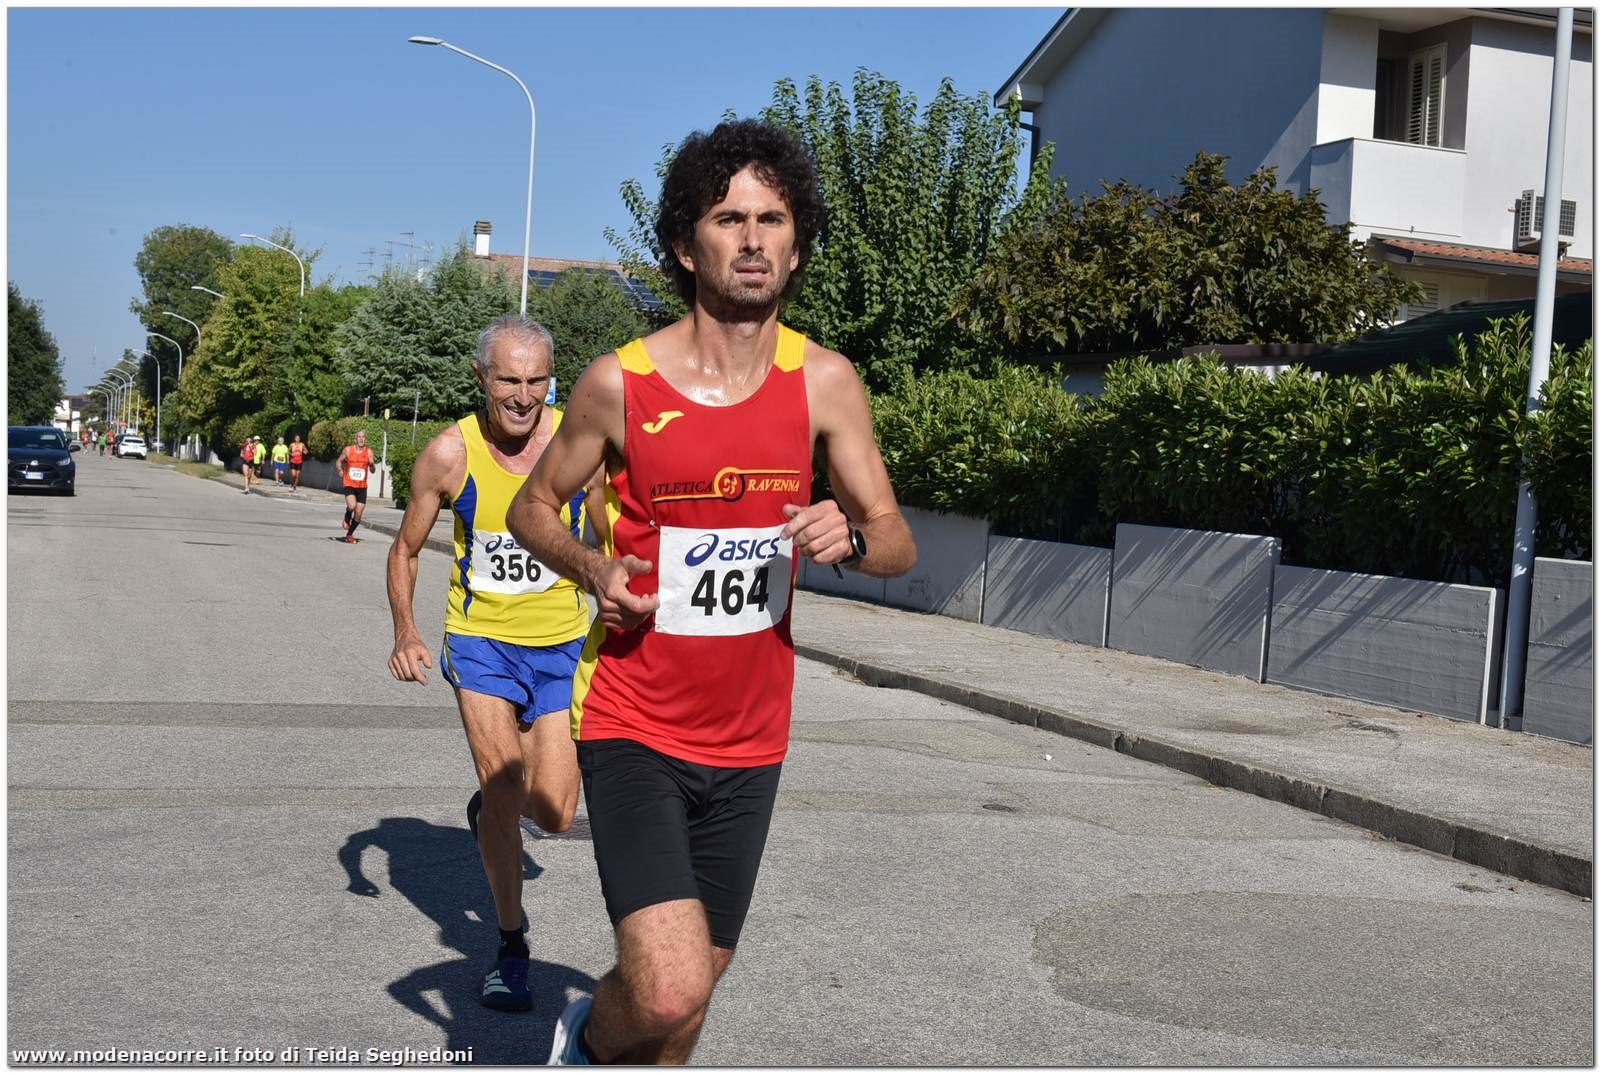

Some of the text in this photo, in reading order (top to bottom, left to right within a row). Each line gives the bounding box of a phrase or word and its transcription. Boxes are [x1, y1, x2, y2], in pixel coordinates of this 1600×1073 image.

[651, 479, 800, 496] ATLETICA RAVENNA
[490, 554, 541, 582] 356
[691, 566, 769, 616] 464
